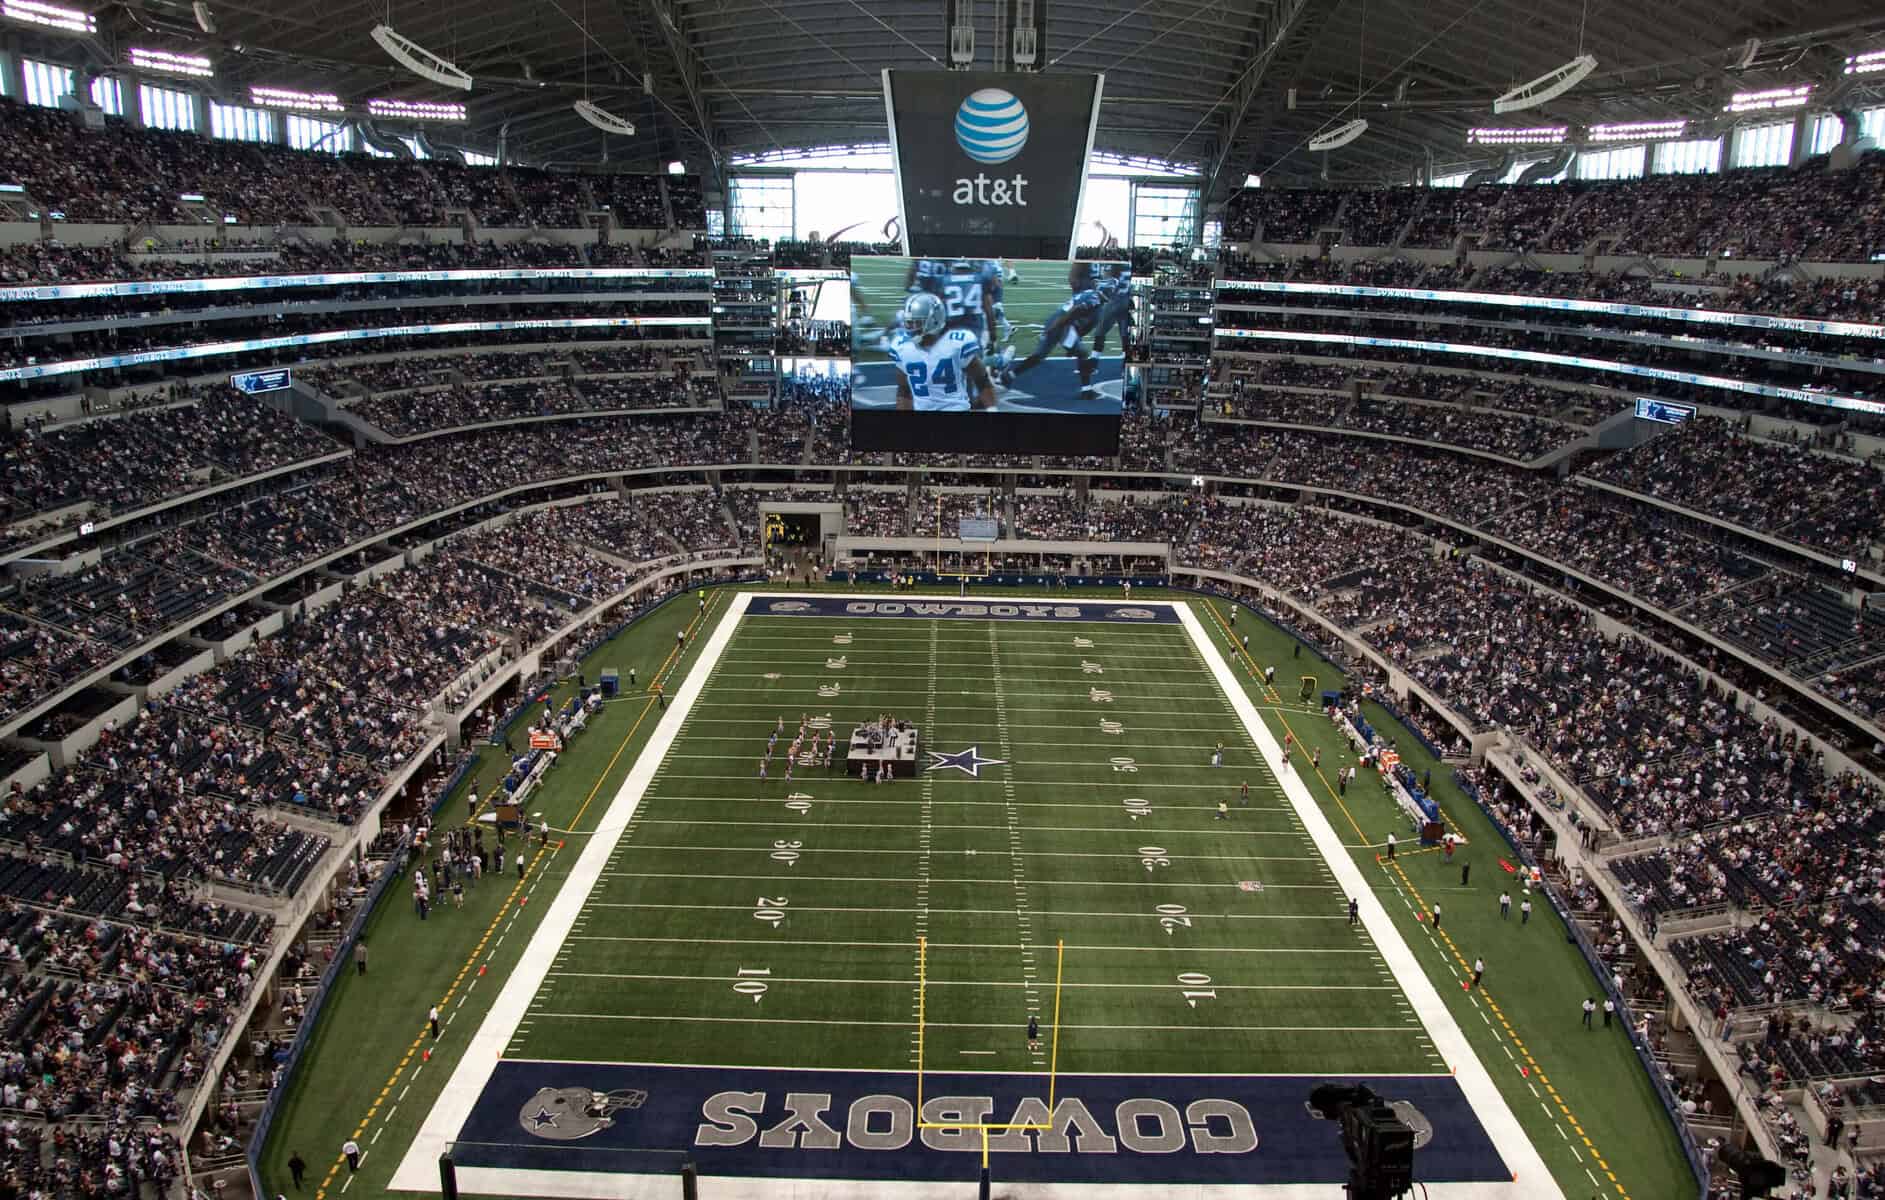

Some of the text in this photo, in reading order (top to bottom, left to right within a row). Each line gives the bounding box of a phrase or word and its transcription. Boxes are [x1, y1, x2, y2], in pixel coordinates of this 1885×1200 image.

[952, 172, 1028, 206] at&t
[944, 283, 983, 317] 24
[514, 320, 553, 328] COWBOYS
[1768, 318, 1805, 330] COWBOYS
[906, 358, 958, 397] 24
[846, 602, 1081, 618] COWBOYS
[1110, 757, 1138, 772] 50
[785, 792, 815, 809] 40
[1123, 798, 1152, 815] 40
[770, 839, 802, 860] 30
[1138, 846, 1170, 867] 30
[753, 896, 788, 920] 20
[1156, 904, 1191, 927] 20
[733, 965, 771, 993] 10
[1177, 972, 1217, 999] 10
[694, 1091, 1259, 1154] COWBOYS
